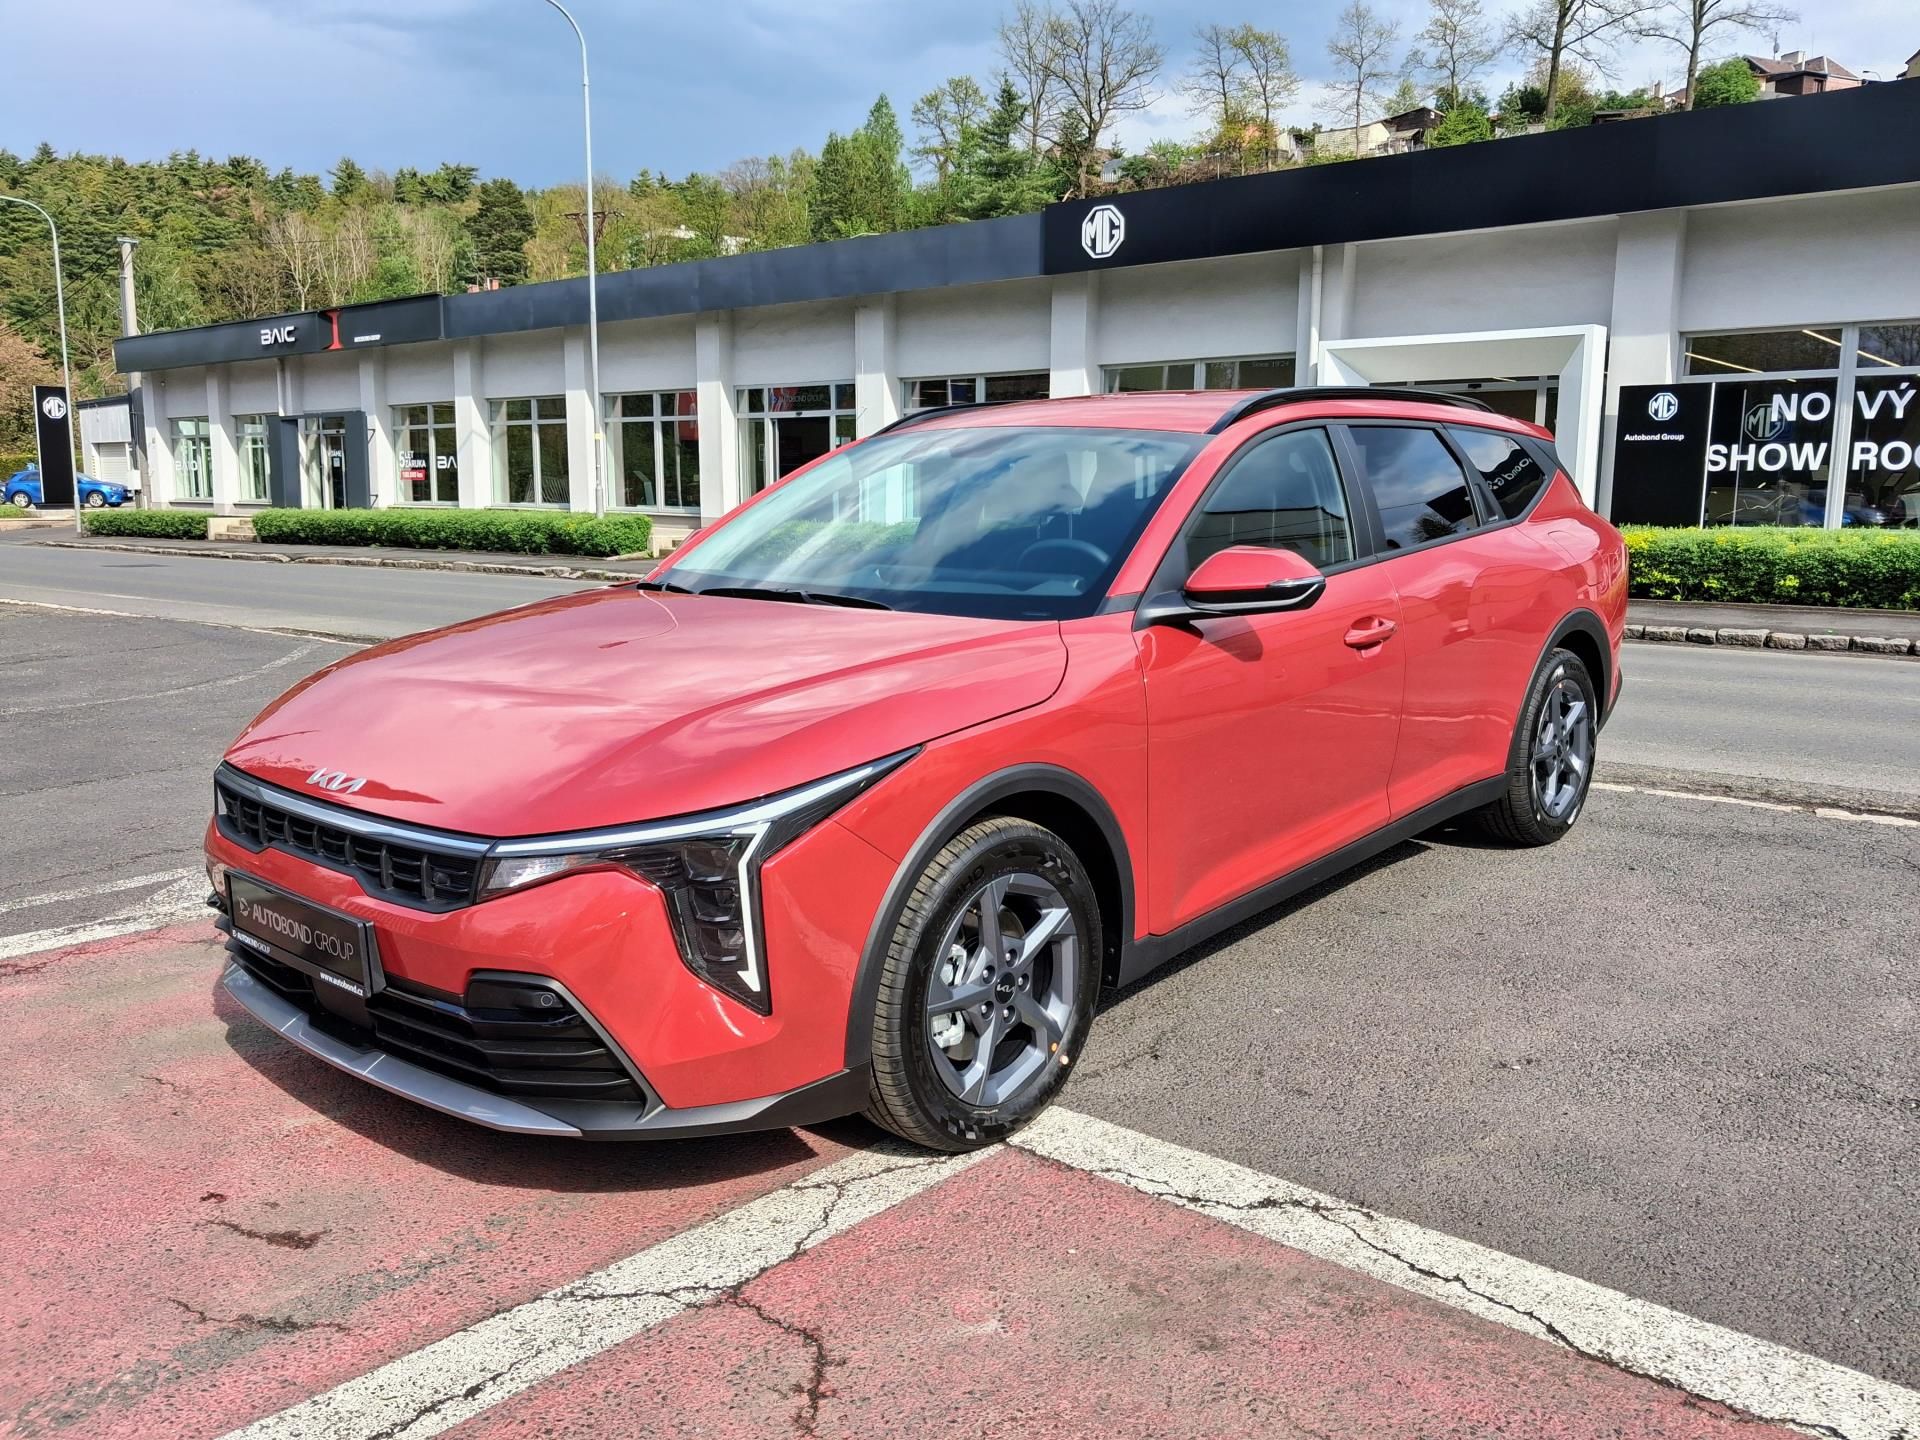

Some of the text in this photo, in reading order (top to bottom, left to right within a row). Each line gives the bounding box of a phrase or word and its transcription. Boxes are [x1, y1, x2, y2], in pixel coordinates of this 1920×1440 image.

[1084, 207, 1121, 255] MG
[261, 325, 296, 345] BAIC
[44, 398, 65, 418] MG
[1650, 394, 1677, 419] MG
[1661, 434, 1685, 442] Group
[437, 455, 458, 469] BA
[1707, 440, 1920, 472] SHOW RO
[305, 767, 368, 794] KIA
[252, 903, 354, 960] AUTOBOND GROUP
